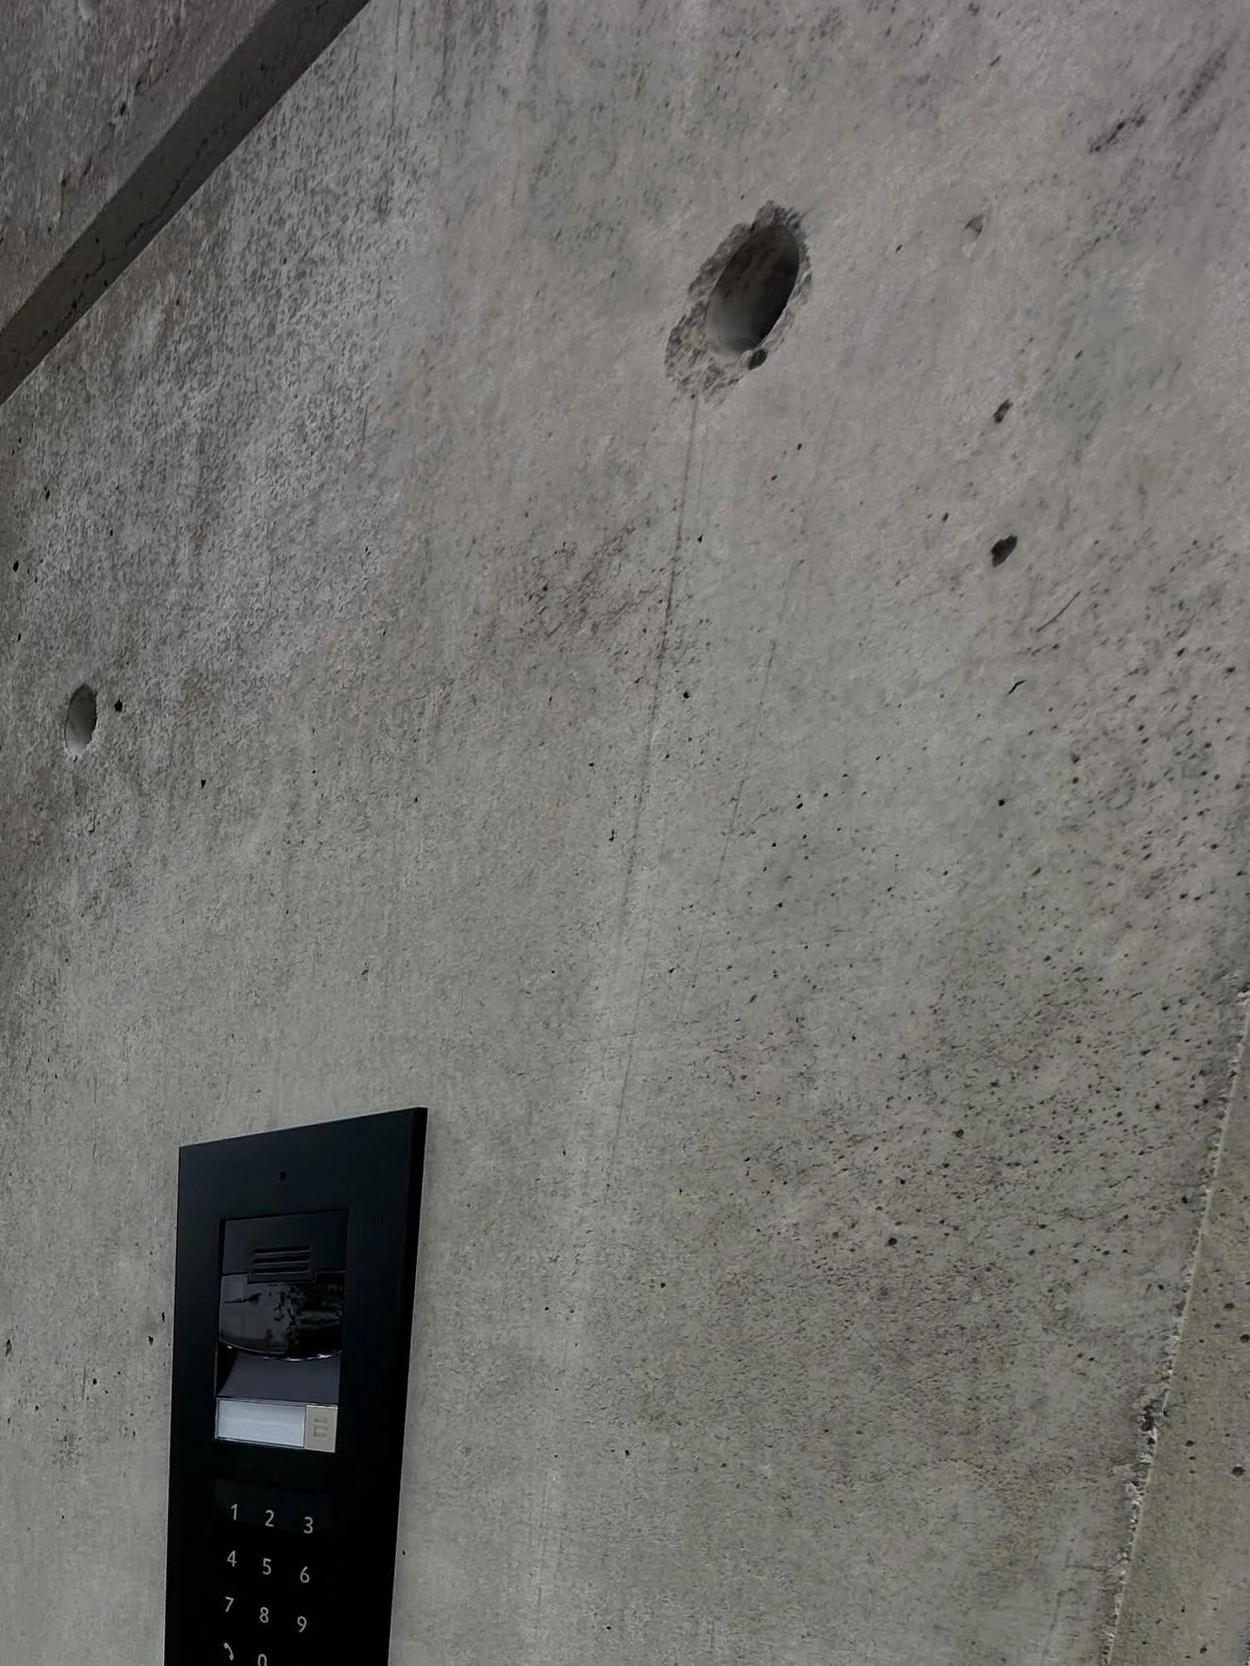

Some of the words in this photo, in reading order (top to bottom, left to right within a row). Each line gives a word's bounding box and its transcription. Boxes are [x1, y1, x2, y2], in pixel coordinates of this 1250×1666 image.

[230, 1503, 238, 1521] 1
[264, 1509, 275, 1528] 2
[303, 1515, 314, 1534] 3
[226, 1550, 237, 1567] 4
[262, 1557, 272, 1576] 5
[299, 1565, 310, 1584] 6
[224, 1596, 235, 1613] 7
[259, 1606, 270, 1624] 8
[296, 1615, 308, 1633] 9
